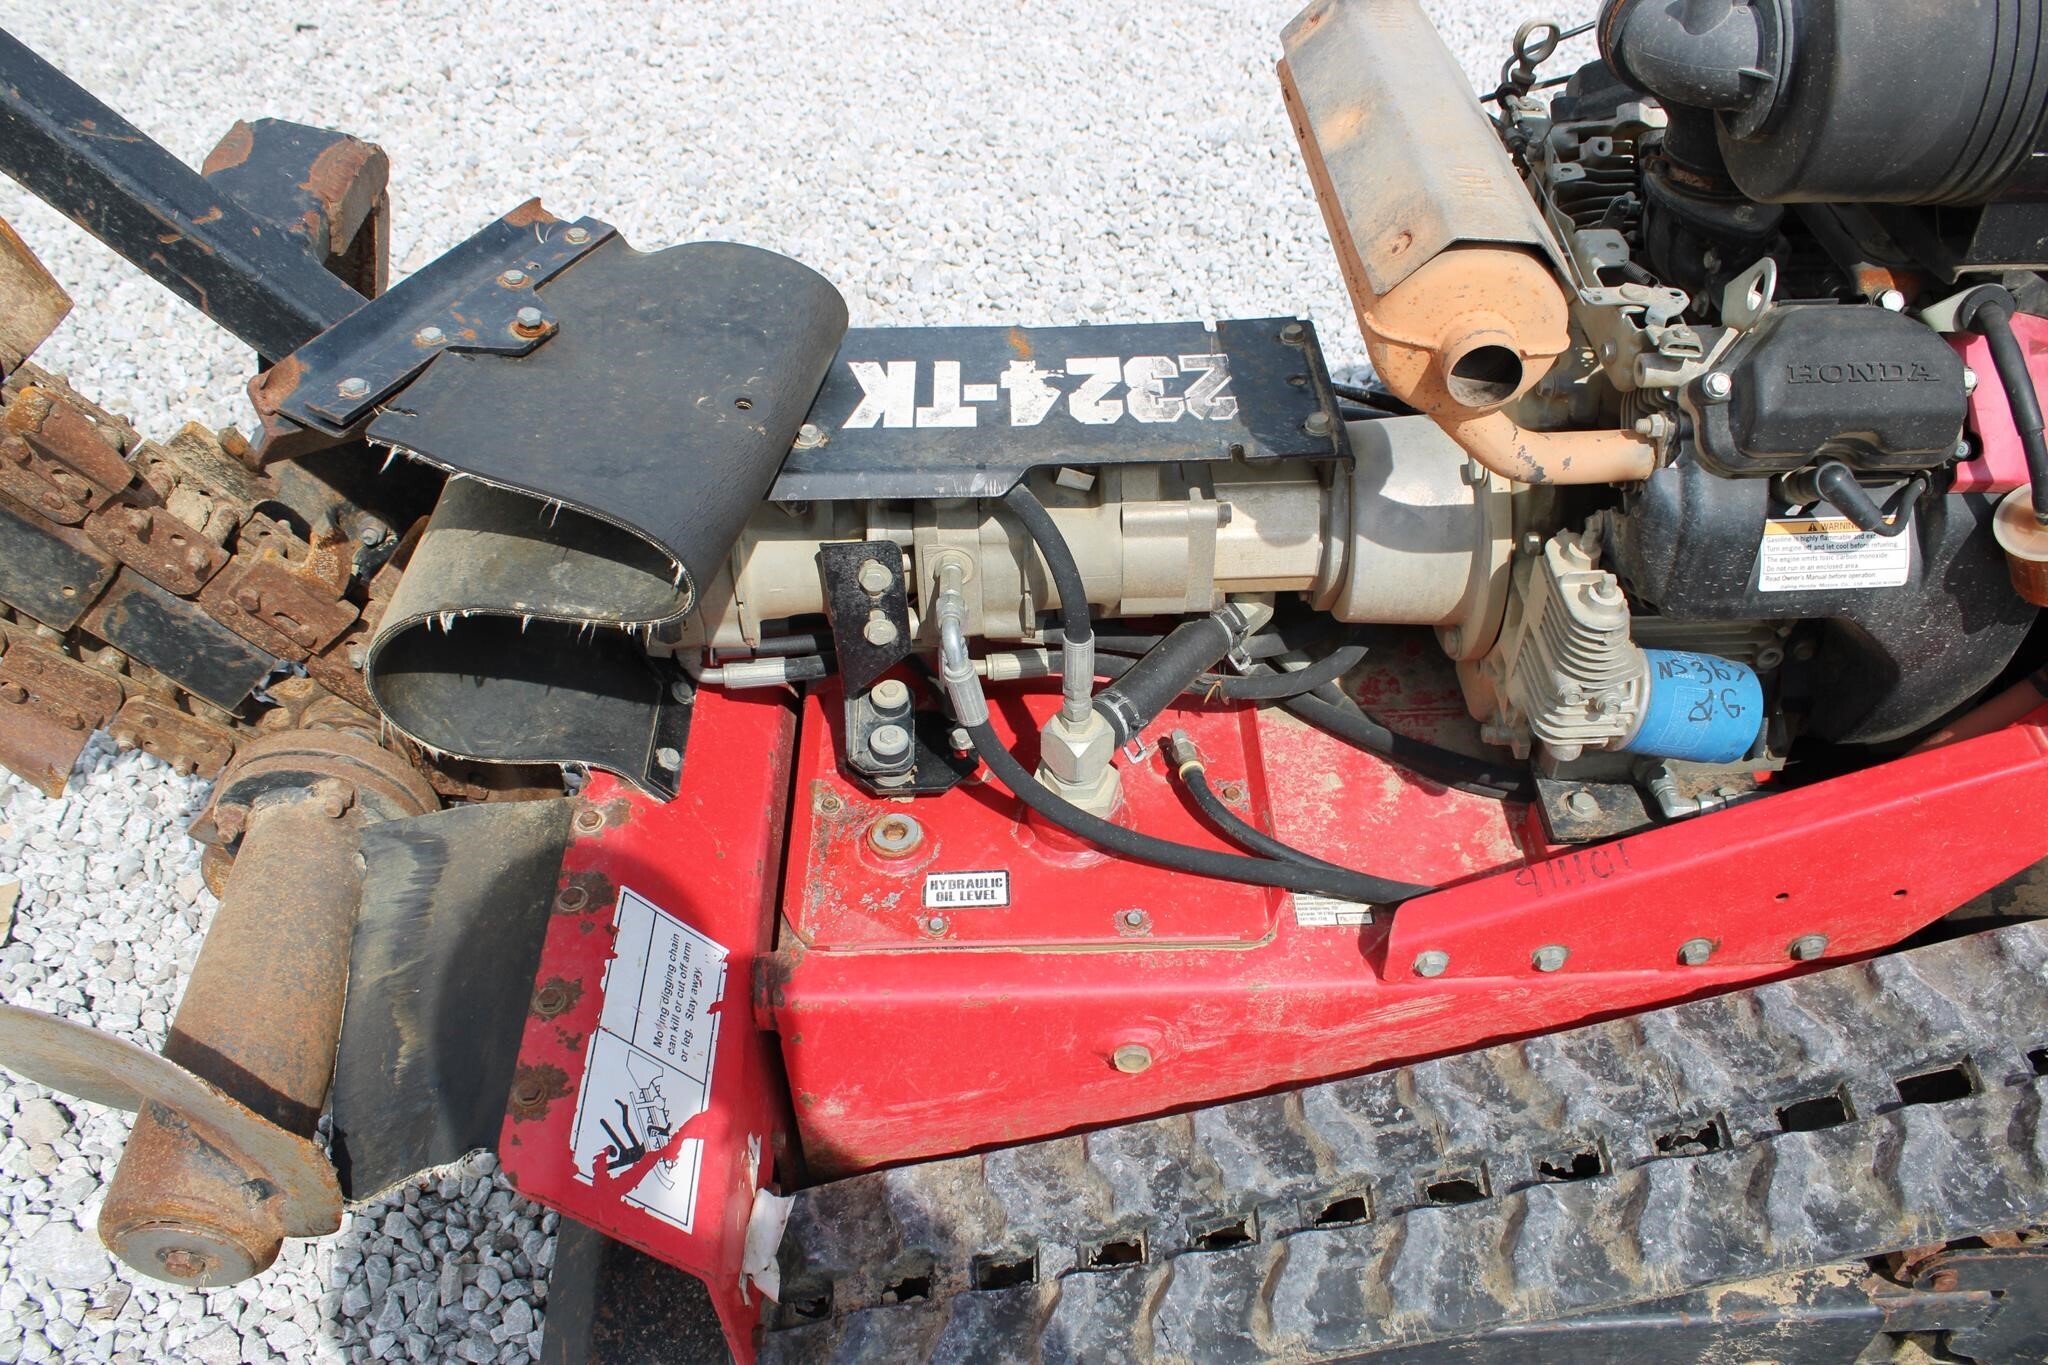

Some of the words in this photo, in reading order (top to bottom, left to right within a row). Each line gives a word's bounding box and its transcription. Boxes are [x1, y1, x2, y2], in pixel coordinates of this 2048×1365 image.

[1786, 362, 1941, 385] HONDA
[842, 354, 1239, 429] 2324-TK
[930, 878, 1003, 891] HYDRAULIC
[936, 891, 955, 902] OIL
[960, 890, 998, 900] LEVEL
[683, 942, 692, 962] arm
[661, 964, 676, 1005] digging
[669, 933, 680, 962] chain
[679, 964, 688, 979] off
[676, 982, 686, 999] cut
[675, 1002, 682, 1012] or
[685, 998, 698, 1021] Stay
[670, 1016, 680, 1032] kill
[668, 1034, 677, 1055] can
[681, 1029, 694, 1049] leg.
[680, 1050, 688, 1062] or
